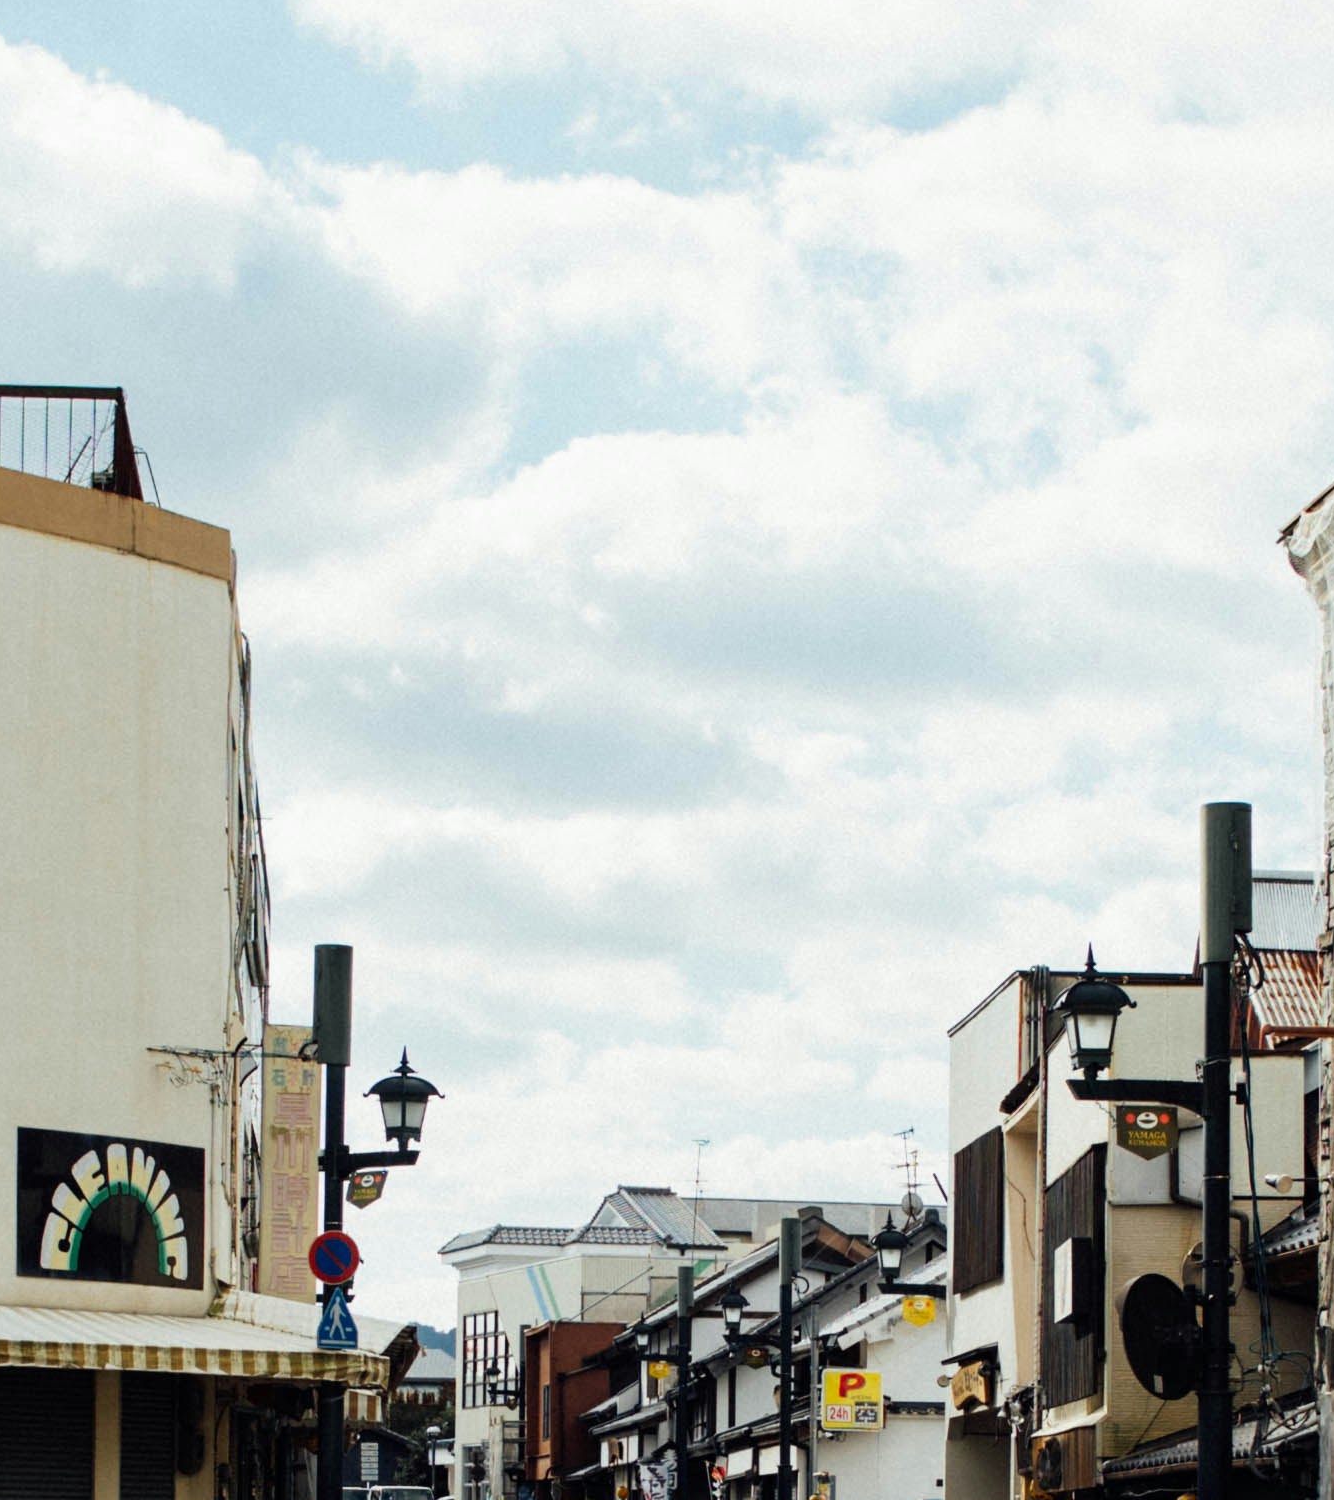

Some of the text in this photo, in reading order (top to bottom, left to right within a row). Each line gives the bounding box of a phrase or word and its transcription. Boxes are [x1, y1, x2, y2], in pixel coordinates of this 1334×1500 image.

[1128, 1131, 1167, 1139] YAMAGA
[40, 1143, 188, 1281] CLEANING
[838, 1373, 866, 1397] P
[829, 1406, 849, 1420] 24h
